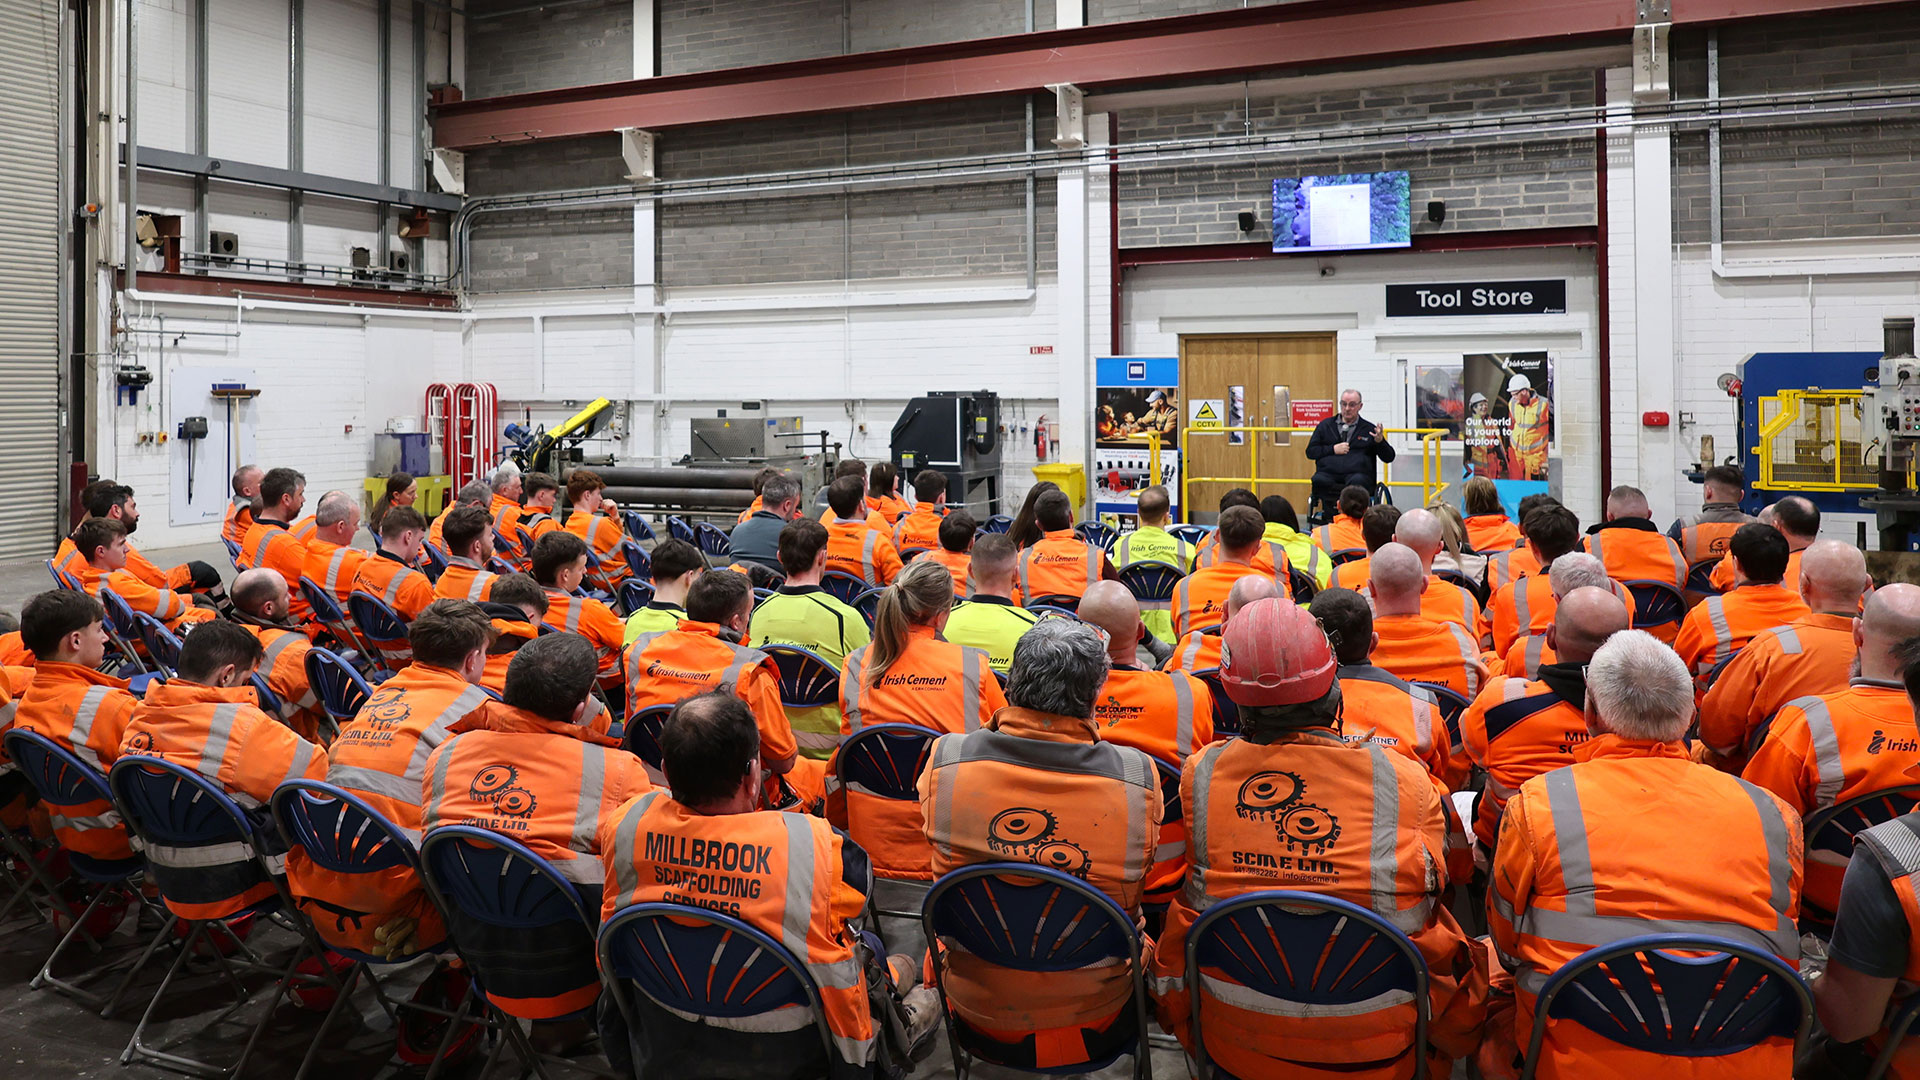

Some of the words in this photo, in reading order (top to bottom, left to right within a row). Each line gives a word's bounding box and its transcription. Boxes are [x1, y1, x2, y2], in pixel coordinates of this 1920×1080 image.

[1416, 289, 1461, 308] Tool
[1471, 288, 1533, 307] Store
[1465, 418, 1482, 426] Our
[1484, 417, 1512, 426] world
[1465, 428, 1472, 436] is
[1474, 429, 1500, 437] yours
[1502, 428, 1512, 436] to
[1465, 437, 1500, 446] explore
[656, 666, 674, 677] Irish
[675, 671, 711, 681] Cement
[884, 674, 906, 686] Irish
[907, 674, 947, 686] Cement
[371, 732, 394, 741] LTD.
[1887, 738, 1918, 752] Irish
[502, 820, 530, 831] LTD.
[644, 831, 773, 875] MILLBROOK
[1232, 851, 1292, 870] SCME
[1298, 858, 1340, 874] LTD.
[654, 865, 761, 900] SCAFFOLDING
[1282, 871, 1340, 884] info@scme.ie
